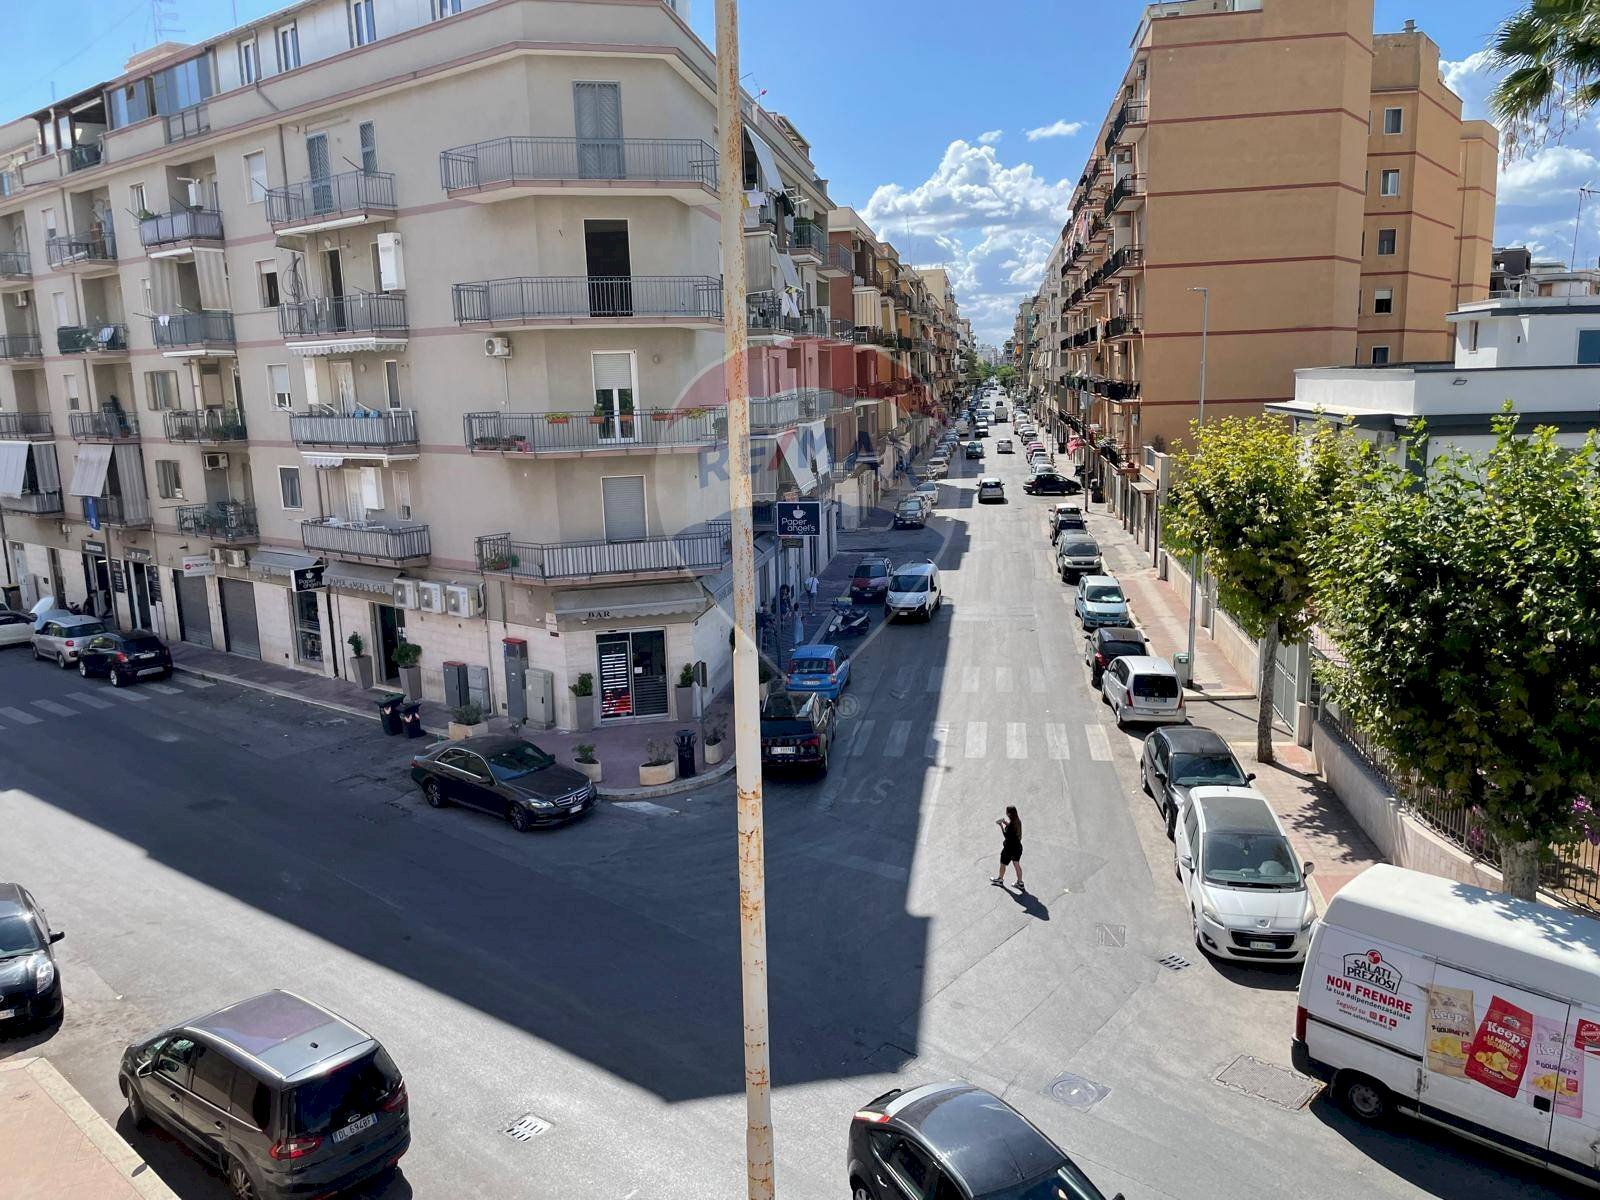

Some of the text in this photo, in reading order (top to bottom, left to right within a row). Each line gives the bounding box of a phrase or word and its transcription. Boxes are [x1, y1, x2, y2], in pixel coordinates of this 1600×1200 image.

[781, 517, 807, 526] Paper
[787, 524, 816, 535] angel's
[1347, 967, 1396, 990] PREZIOSI
[1354, 959, 1391, 979] SALATI
[1327, 975, 1413, 1013] NON FRENARE
[1487, 1021, 1527, 1048] Keep's
